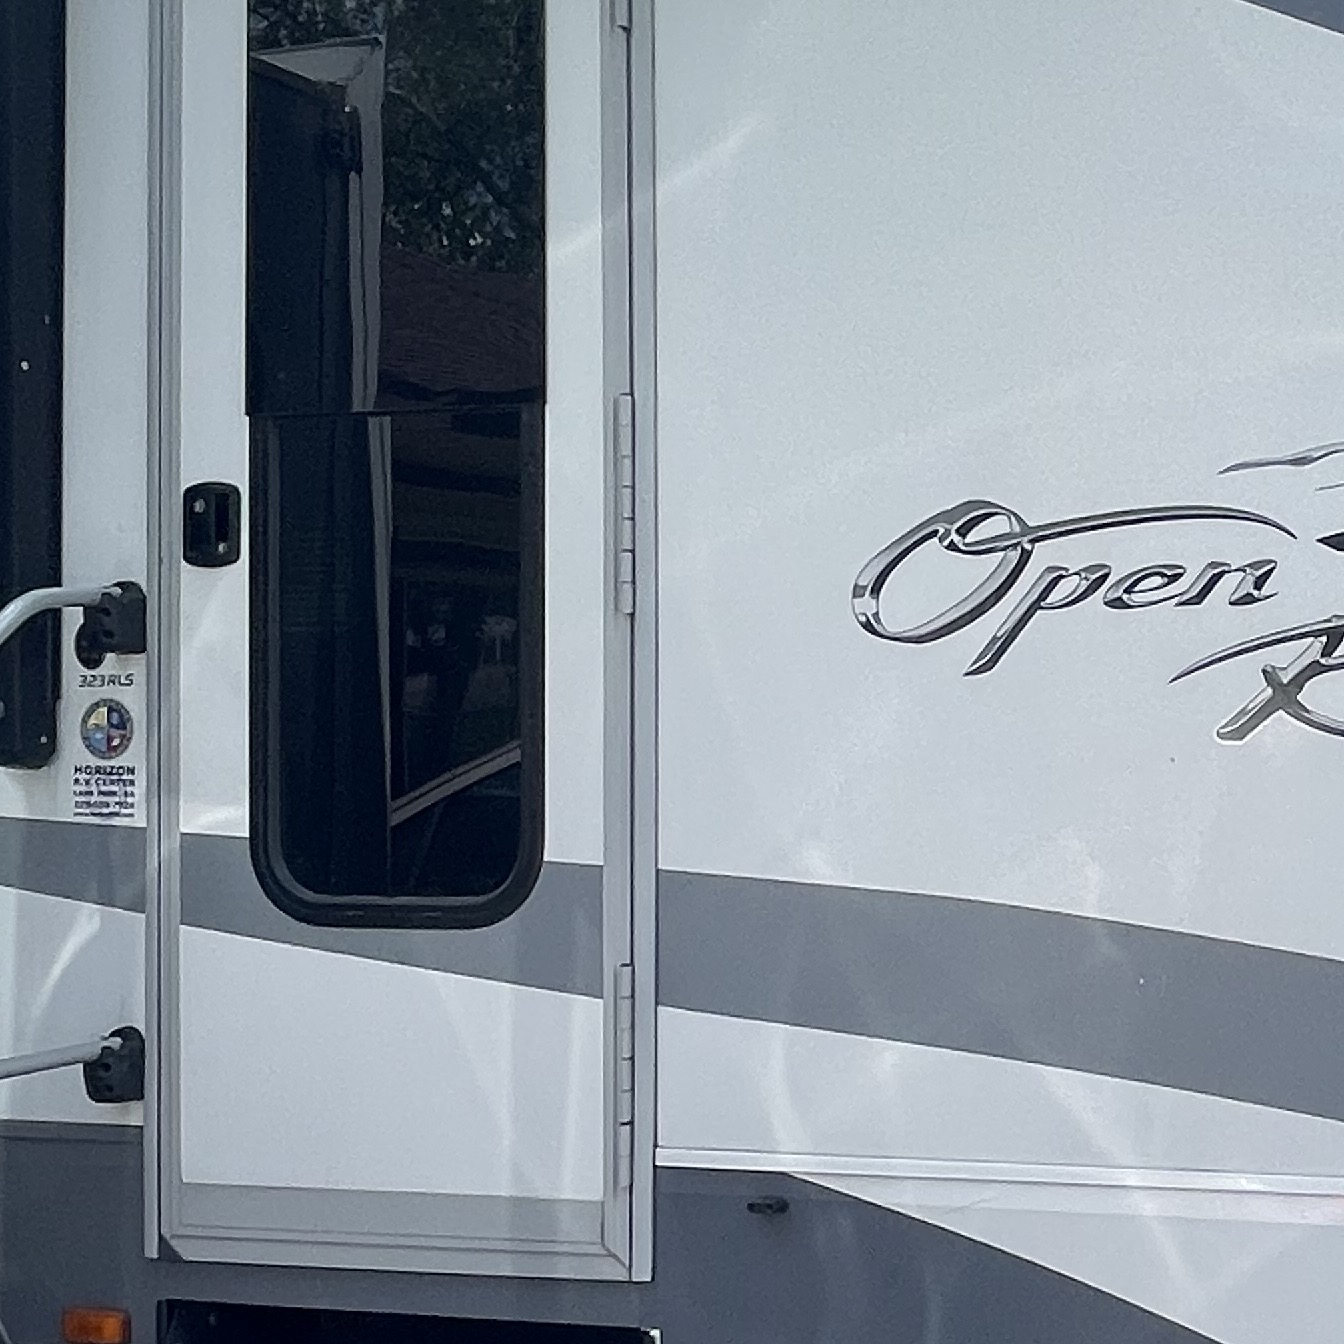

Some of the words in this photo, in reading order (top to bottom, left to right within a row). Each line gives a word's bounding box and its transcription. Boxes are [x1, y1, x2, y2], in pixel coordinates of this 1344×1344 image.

[851, 498, 1298, 677] Open
[78, 672, 134, 688] 323RLS
[74, 764, 135, 775] HORIZON
